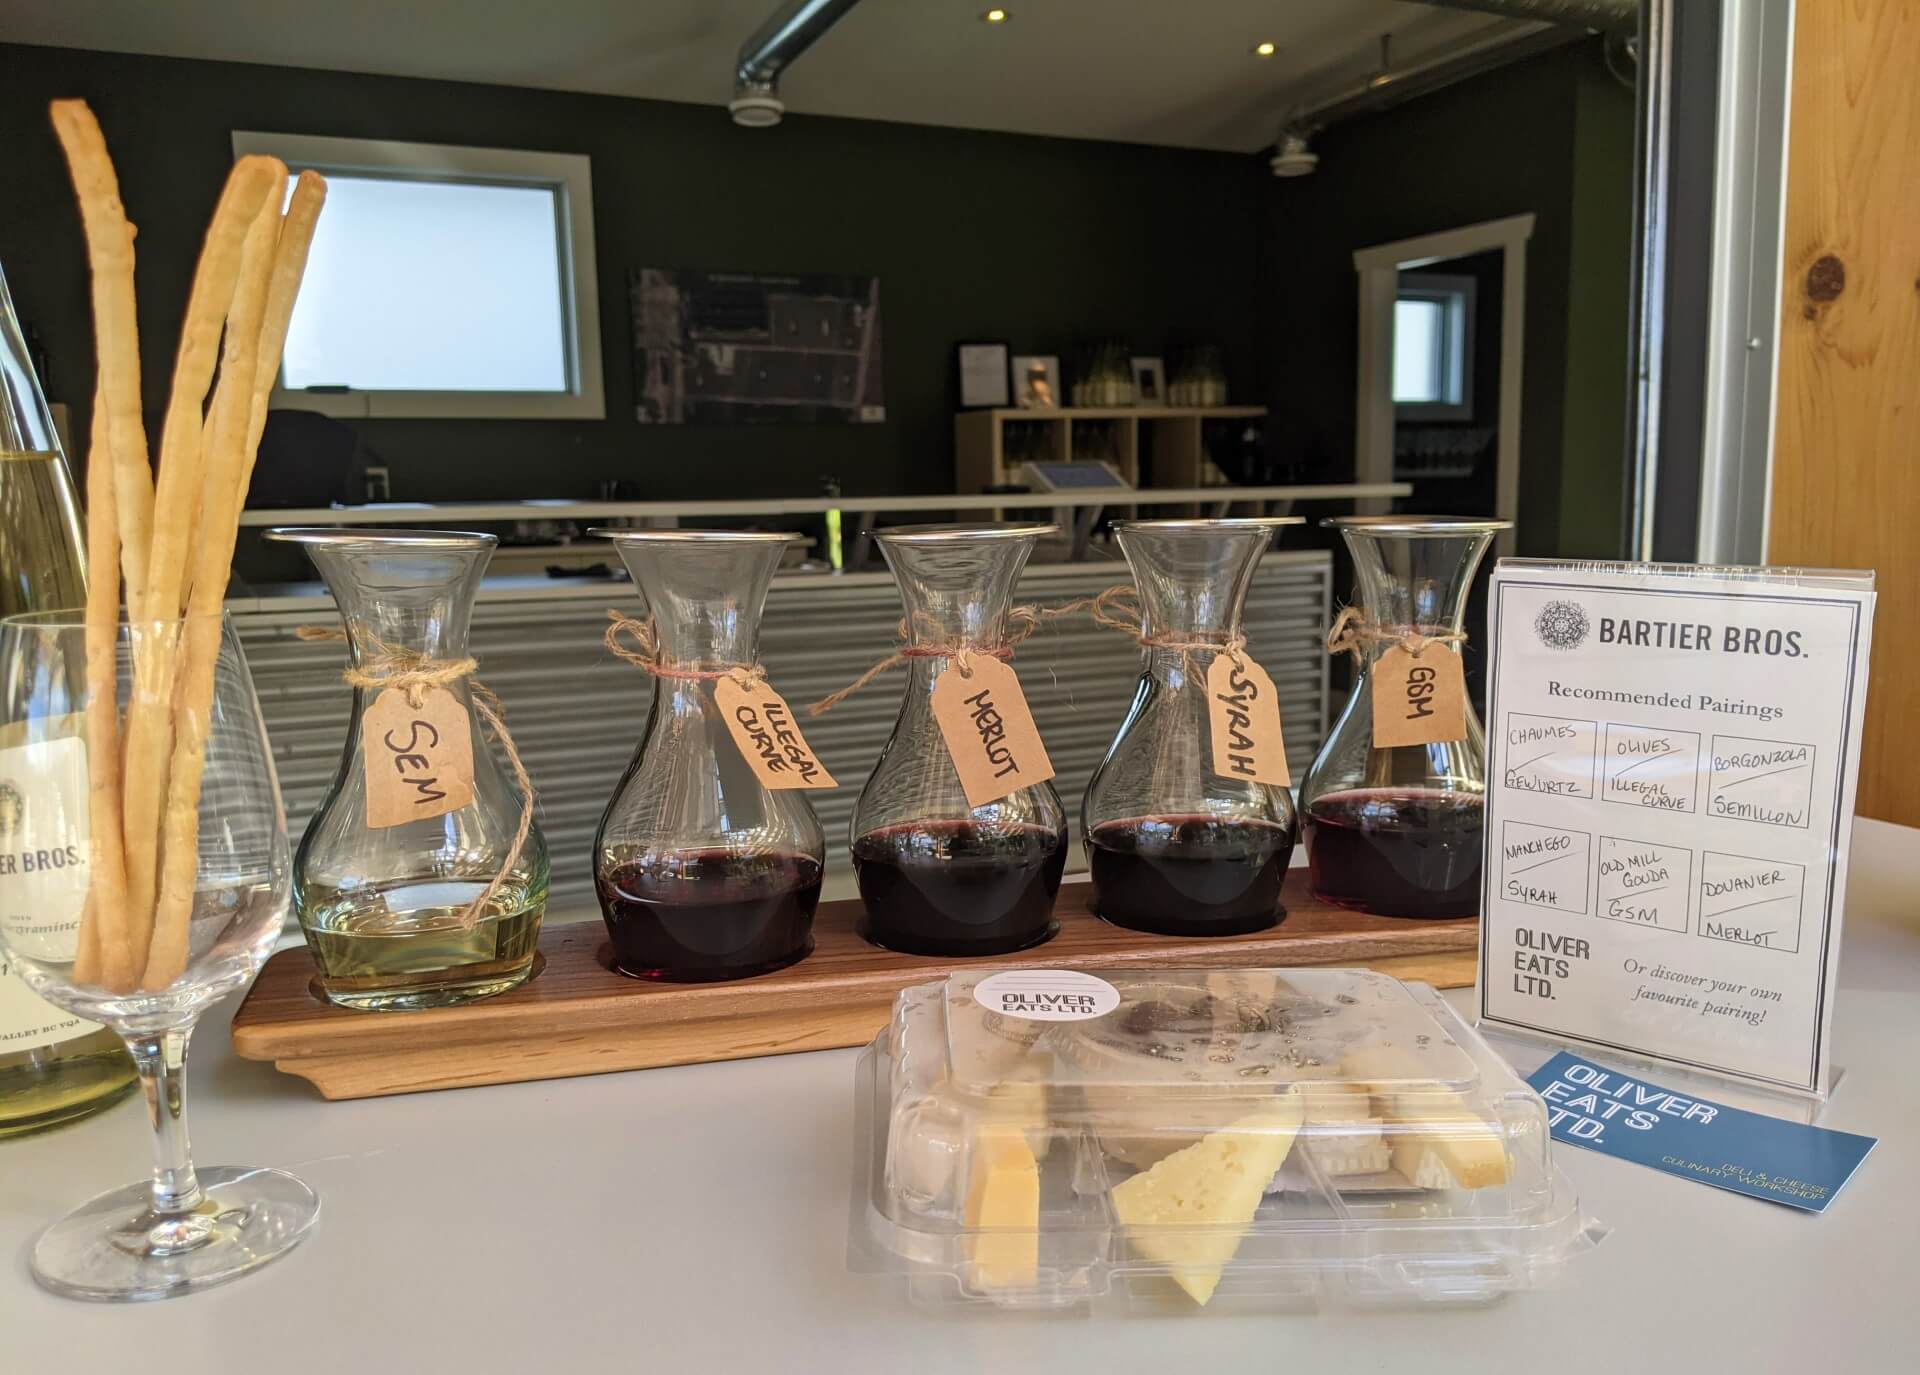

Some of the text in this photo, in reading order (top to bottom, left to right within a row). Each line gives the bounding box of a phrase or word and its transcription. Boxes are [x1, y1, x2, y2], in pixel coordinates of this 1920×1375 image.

[1599, 617, 1809, 659] BARTIER BROS.
[1405, 666, 1436, 720] GSM
[1548, 680, 1784, 722] Recommended Pairings
[963, 688, 1021, 779] MERLOT
[1216, 665, 1258, 777] SYRAH
[1509, 724, 1578, 745] CHAUMES
[735, 705, 794, 773] CURVE
[762, 702, 819, 785] ILLEGAL
[1617, 737, 1671, 756] OLIVES
[384, 719, 448, 805] SEM
[1611, 777, 1668, 796] ILLEGAL
[1641, 793, 1687, 810] CURVE
[1713, 795, 1803, 826] SEMILLON
[22, 844, 87, 874] BROS.
[1505, 835, 1571, 861] MANCHEGO
[1600, 850, 1663, 876] OLD MILL
[1622, 867, 1670, 888] GOUDA
[1507, 879, 1558, 905] SYRAH
[1702, 869, 1786, 897] DOUANIER
[1608, 899, 1659, 925] GSM
[1514, 927, 1591, 960] OLIVER
[1706, 921, 1778, 947] MERLOT
[1514, 950, 1570, 979] EATS
[1513, 973, 1557, 1000] LTD.
[1623, 958, 1783, 1003] Or discover your own
[1001, 993, 1097, 1007] OLIVER
[1002, 1003, 1097, 1014] EATS LTD.
[1630, 984, 1768, 1026] favourite pairing!
[1539, 1080, 1661, 1131] EATS
[1564, 1063, 1719, 1125] OLIVER
[1661, 1155, 1735, 1179] CULINARY
